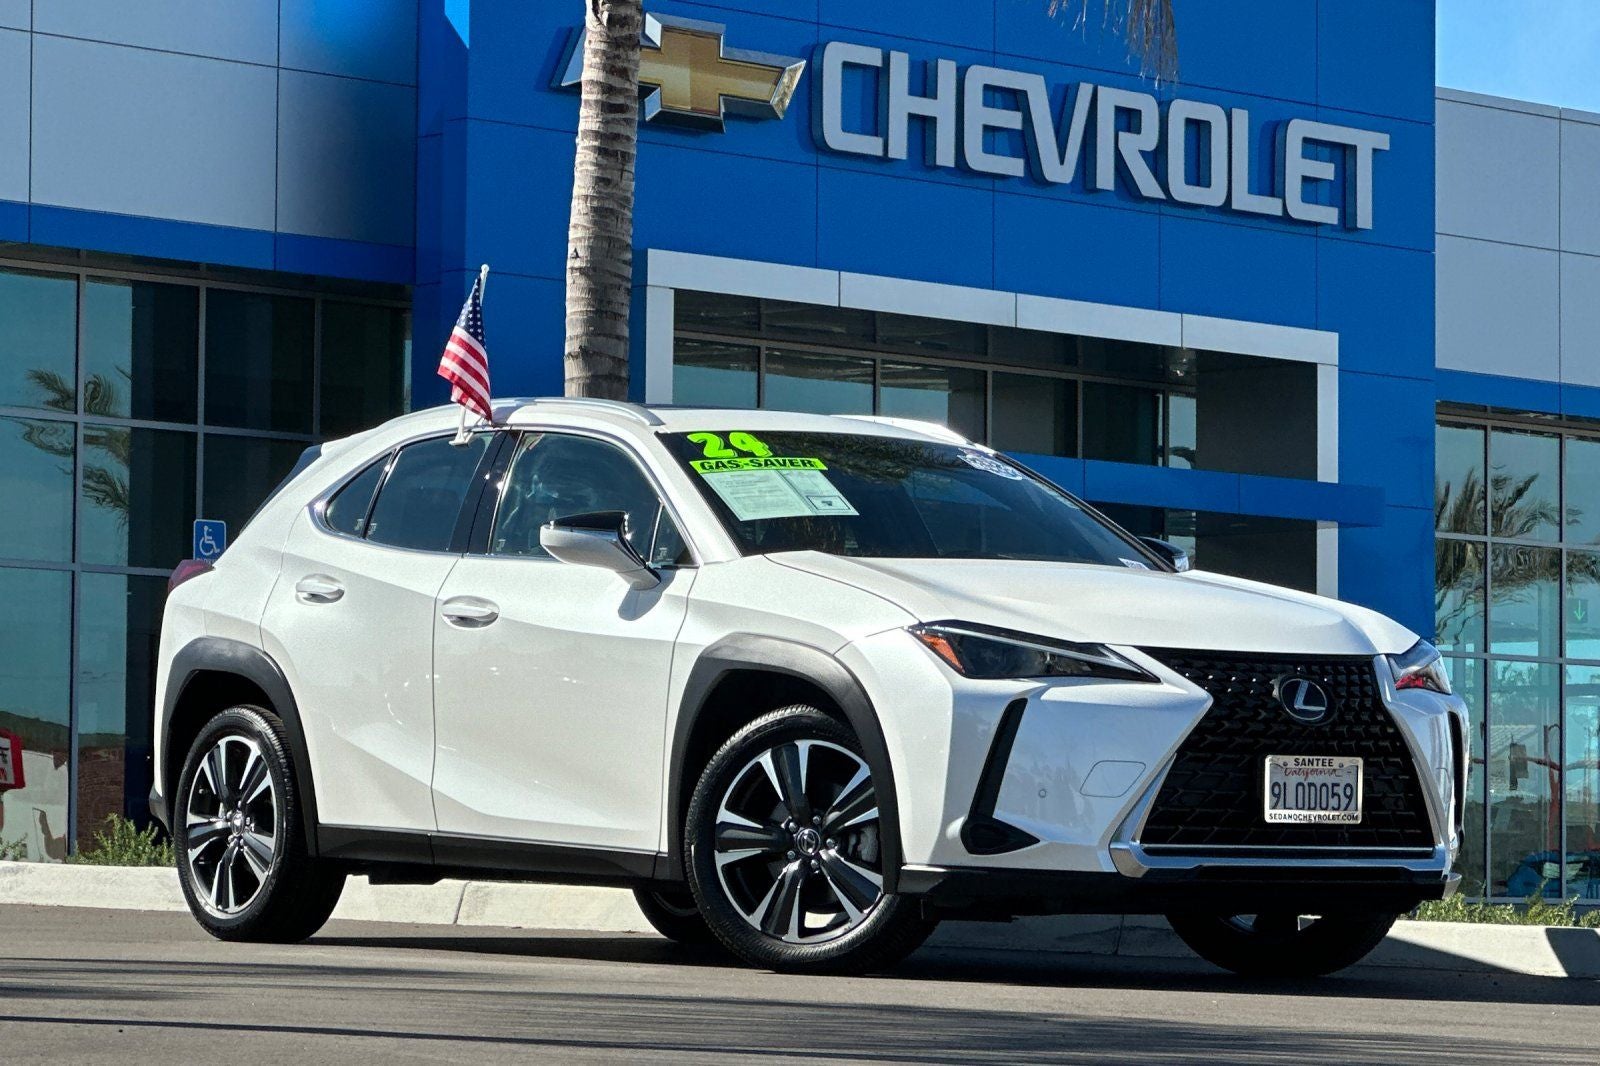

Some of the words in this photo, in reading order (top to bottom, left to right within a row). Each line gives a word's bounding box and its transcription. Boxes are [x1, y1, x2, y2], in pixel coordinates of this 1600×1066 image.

[821, 40, 1391, 231] CHEVROLET
[686, 431, 773, 458] 24
[699, 458, 816, 470] GAS-SAVER
[1293, 757, 1334, 767] SANTEE
